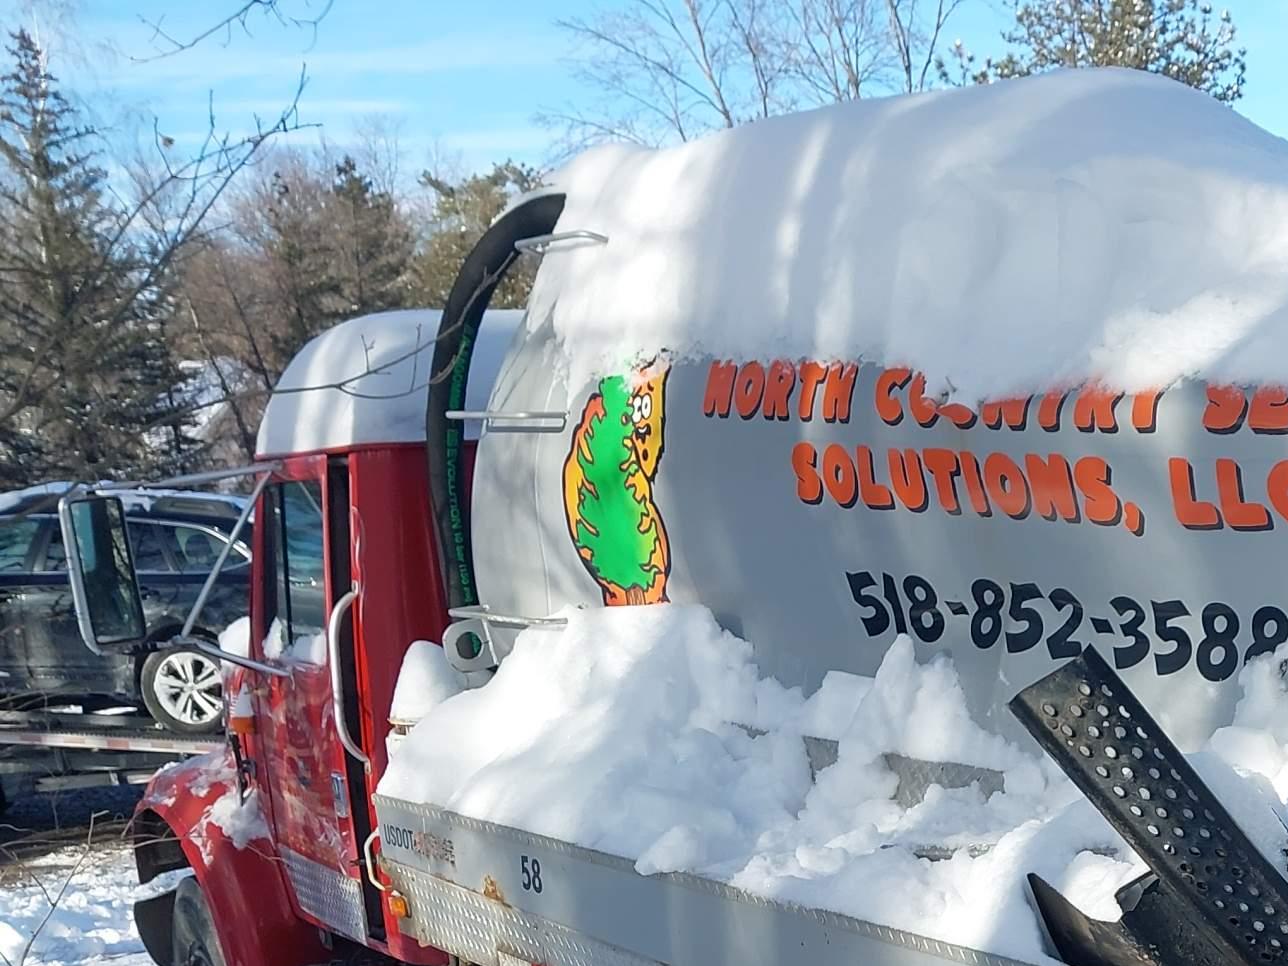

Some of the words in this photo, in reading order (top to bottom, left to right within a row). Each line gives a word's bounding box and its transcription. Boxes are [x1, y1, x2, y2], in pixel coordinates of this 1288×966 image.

[703, 359, 858, 424] NORTH
[791, 441, 1145, 537] SOLUTIONS,
[383, 823, 414, 850] USDOT
[520, 855, 544, 894] 58
